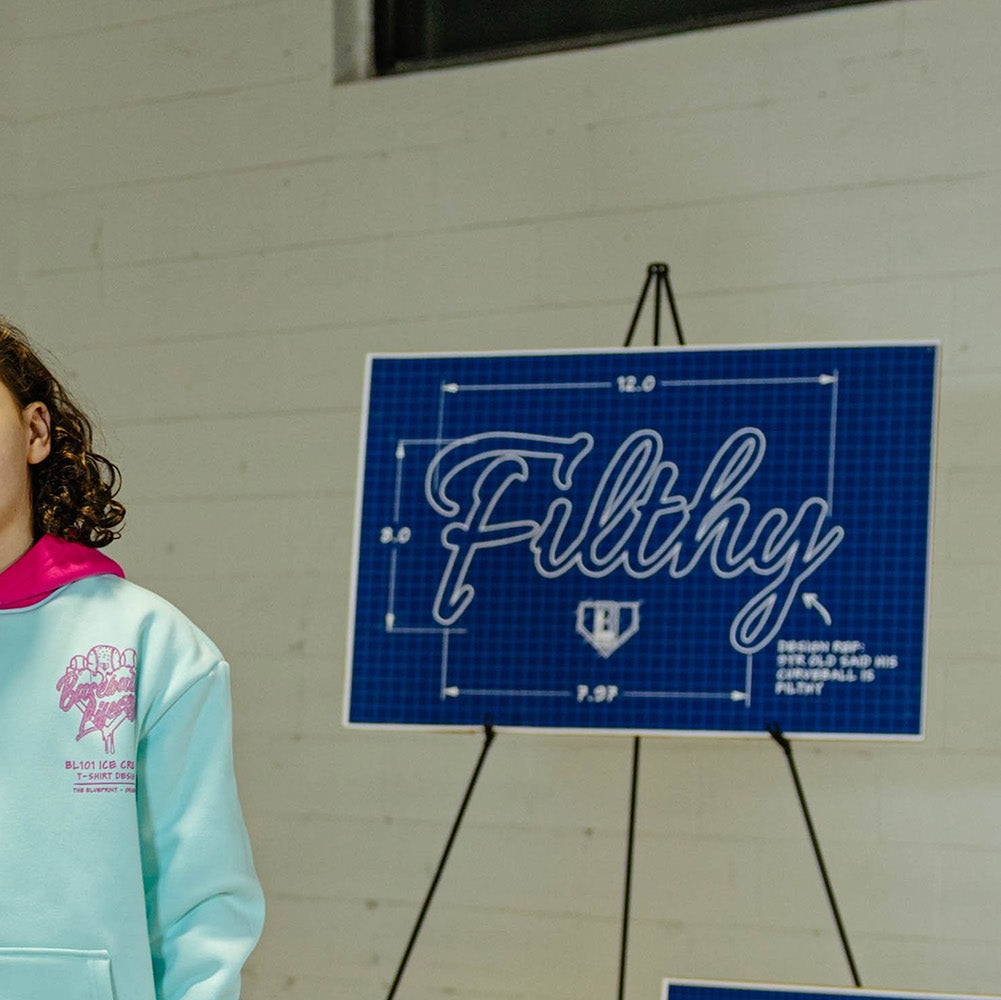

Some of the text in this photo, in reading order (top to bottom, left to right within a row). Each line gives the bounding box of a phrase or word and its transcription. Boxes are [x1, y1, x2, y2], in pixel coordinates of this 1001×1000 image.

[617, 375, 656, 392] 12.0
[424, 426, 845, 653] Filthy
[65, 760, 95, 770] BL101
[99, 760, 116, 770] ICE
[77, 772, 112, 780] T-SHIRT
